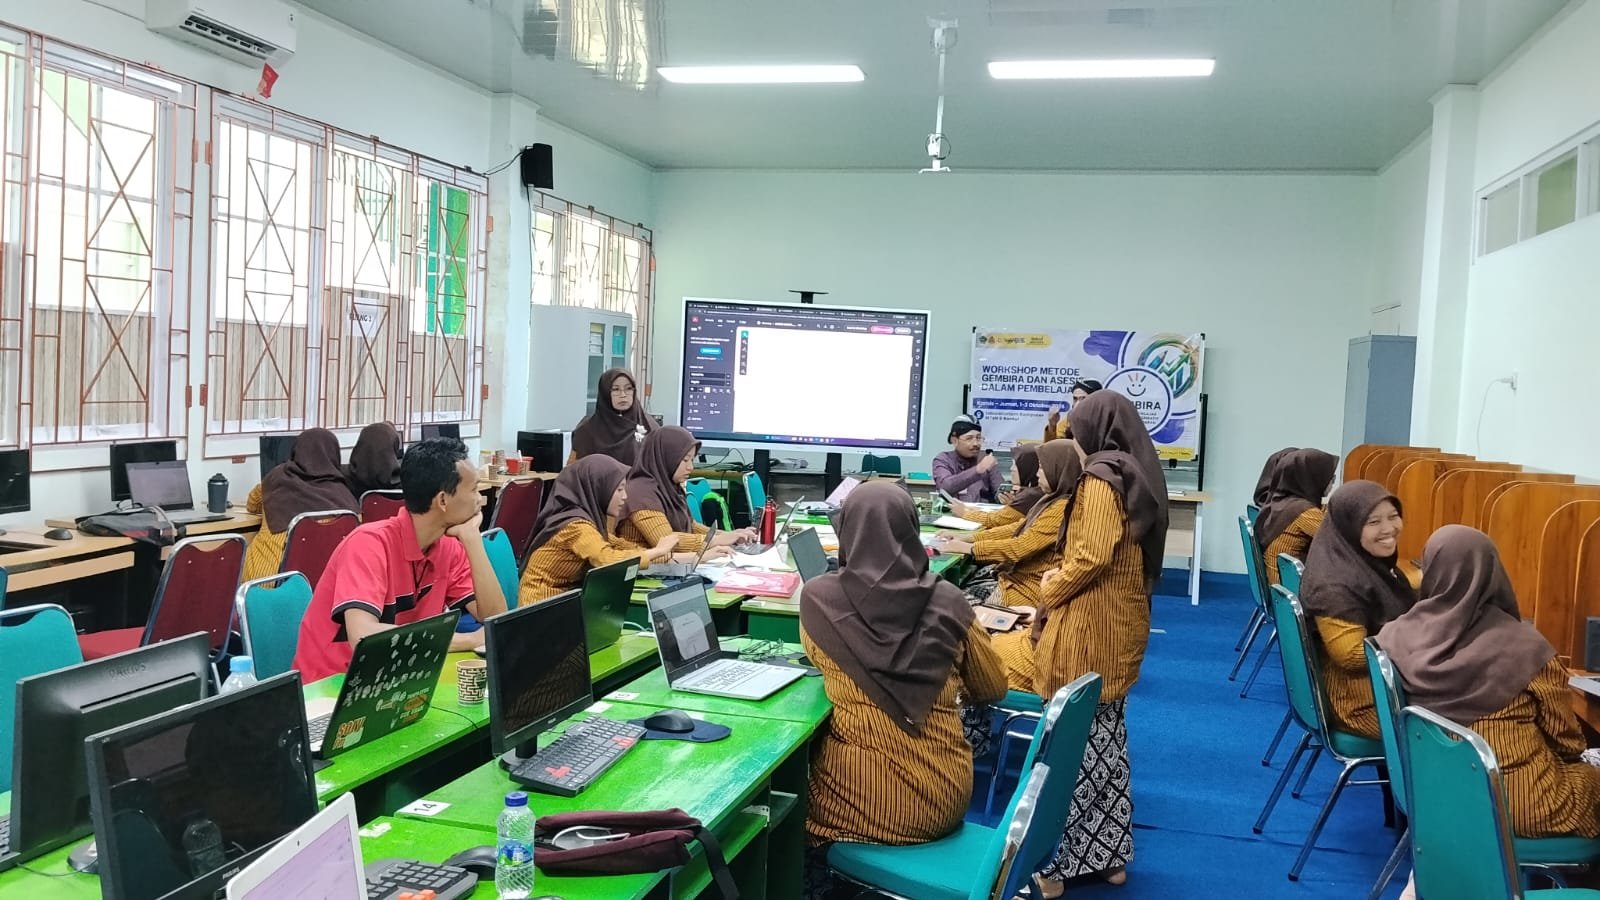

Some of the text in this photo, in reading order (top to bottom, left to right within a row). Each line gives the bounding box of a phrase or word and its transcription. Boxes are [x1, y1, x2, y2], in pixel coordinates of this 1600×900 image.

[982, 365, 1080, 376] WORKSHOP METODE
[981, 374, 1024, 383] GEMBIRA
[1026, 375, 1048, 384] DAN
[981, 383, 1073, 394] DALAM PEMBELAJA
[412, 803, 437, 811] 14
